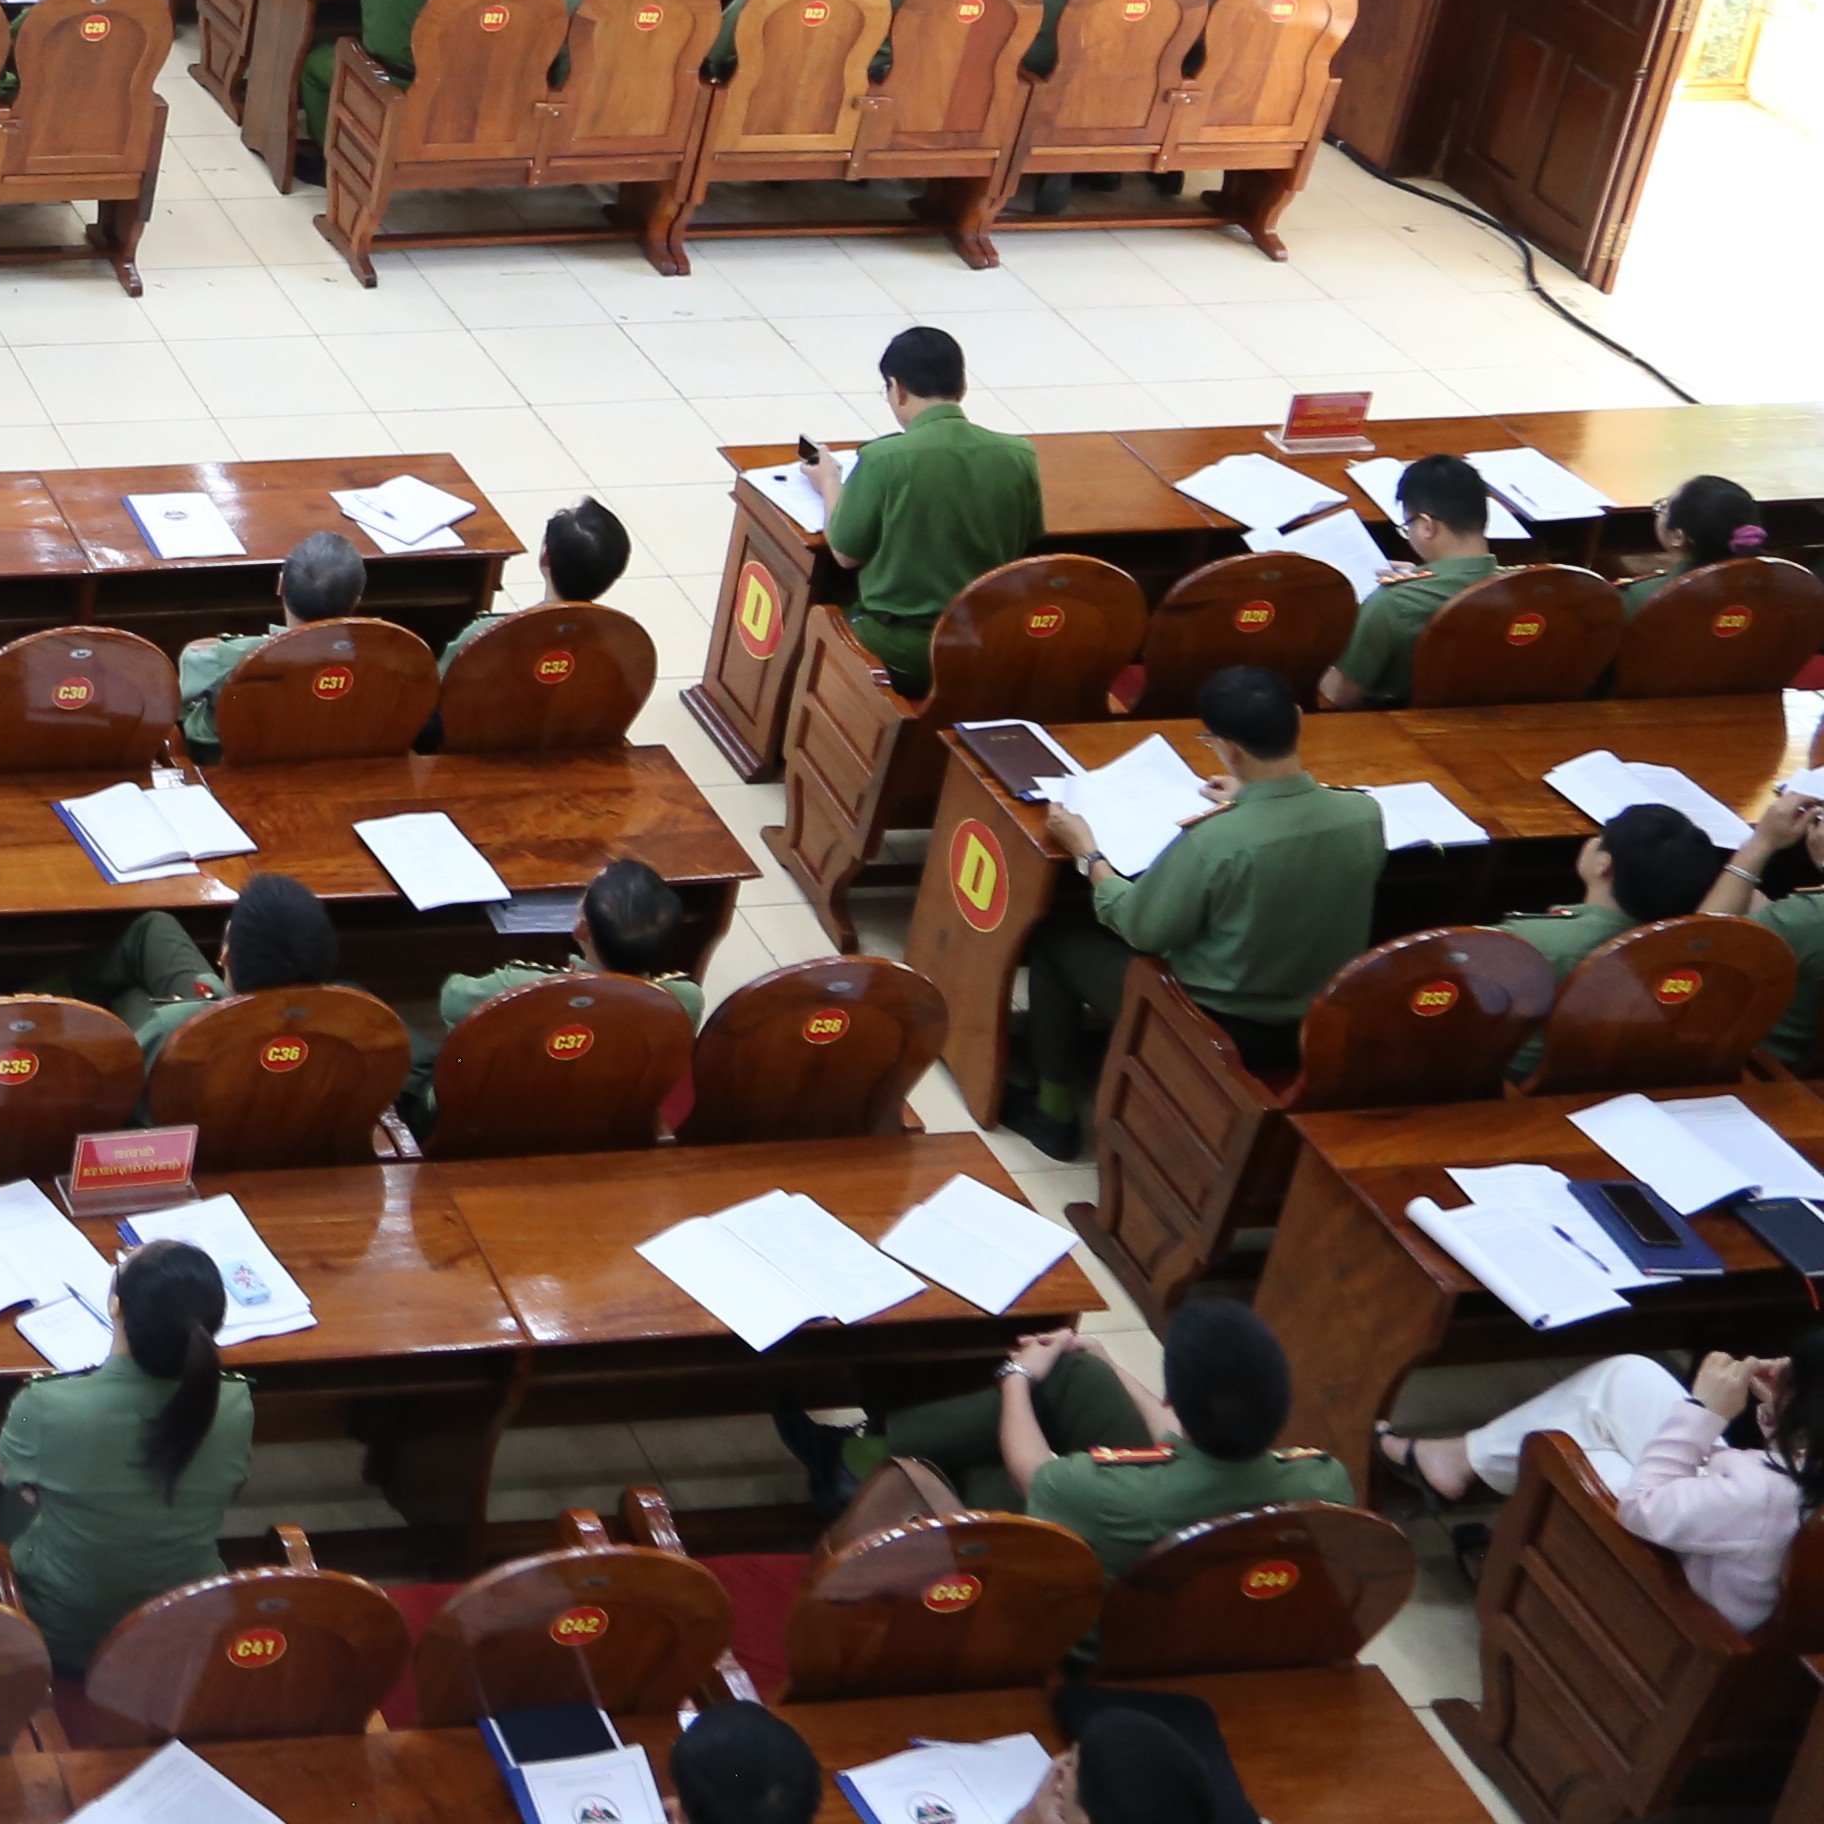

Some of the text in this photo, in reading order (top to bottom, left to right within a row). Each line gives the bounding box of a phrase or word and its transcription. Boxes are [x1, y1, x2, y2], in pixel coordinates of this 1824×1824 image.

[483, 12, 504, 24] D21
[638, 11, 660, 23] D22
[741, 575, 774, 643] D
[1030, 614, 1059, 629] D27
[540, 659, 569, 675] C32
[318, 676, 346, 690] C31
[957, 837, 999, 913] D
[553, 1034, 587, 1050] C37
[236, 1639, 275, 1657] C41
